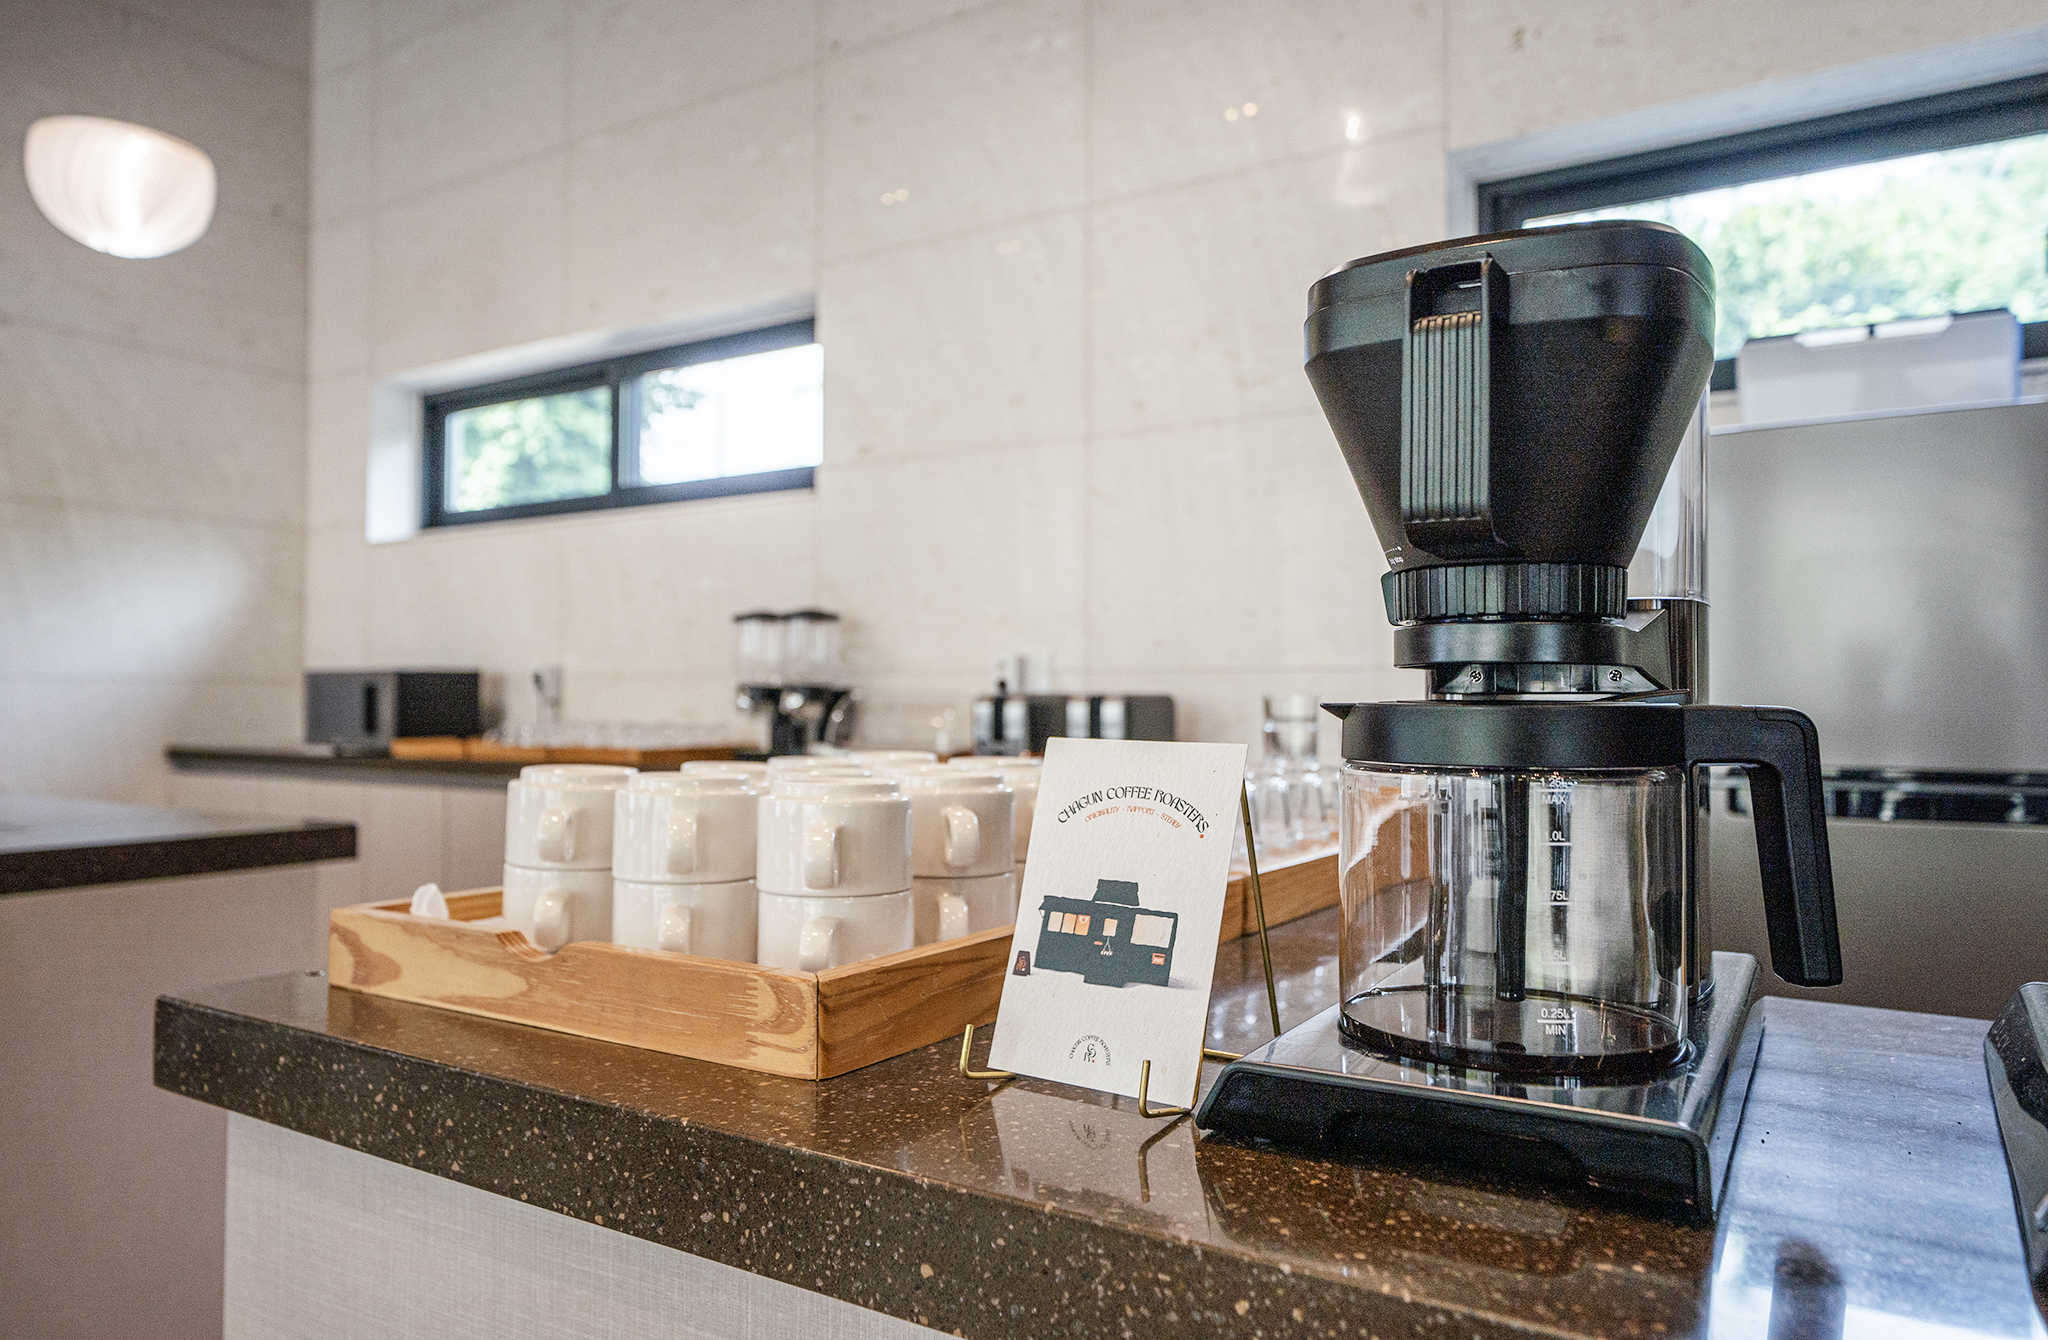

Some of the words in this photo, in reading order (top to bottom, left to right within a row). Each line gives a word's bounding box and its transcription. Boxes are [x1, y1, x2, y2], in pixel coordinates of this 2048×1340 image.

[1057, 790, 1103, 823] CHAGUN
[1106, 786, 1153, 800] COFFEE
[1541, 794, 1566, 805] MAX
[1540, 1007, 1570, 1019] 0.25L
[1545, 1024, 1567, 1036] MIN
